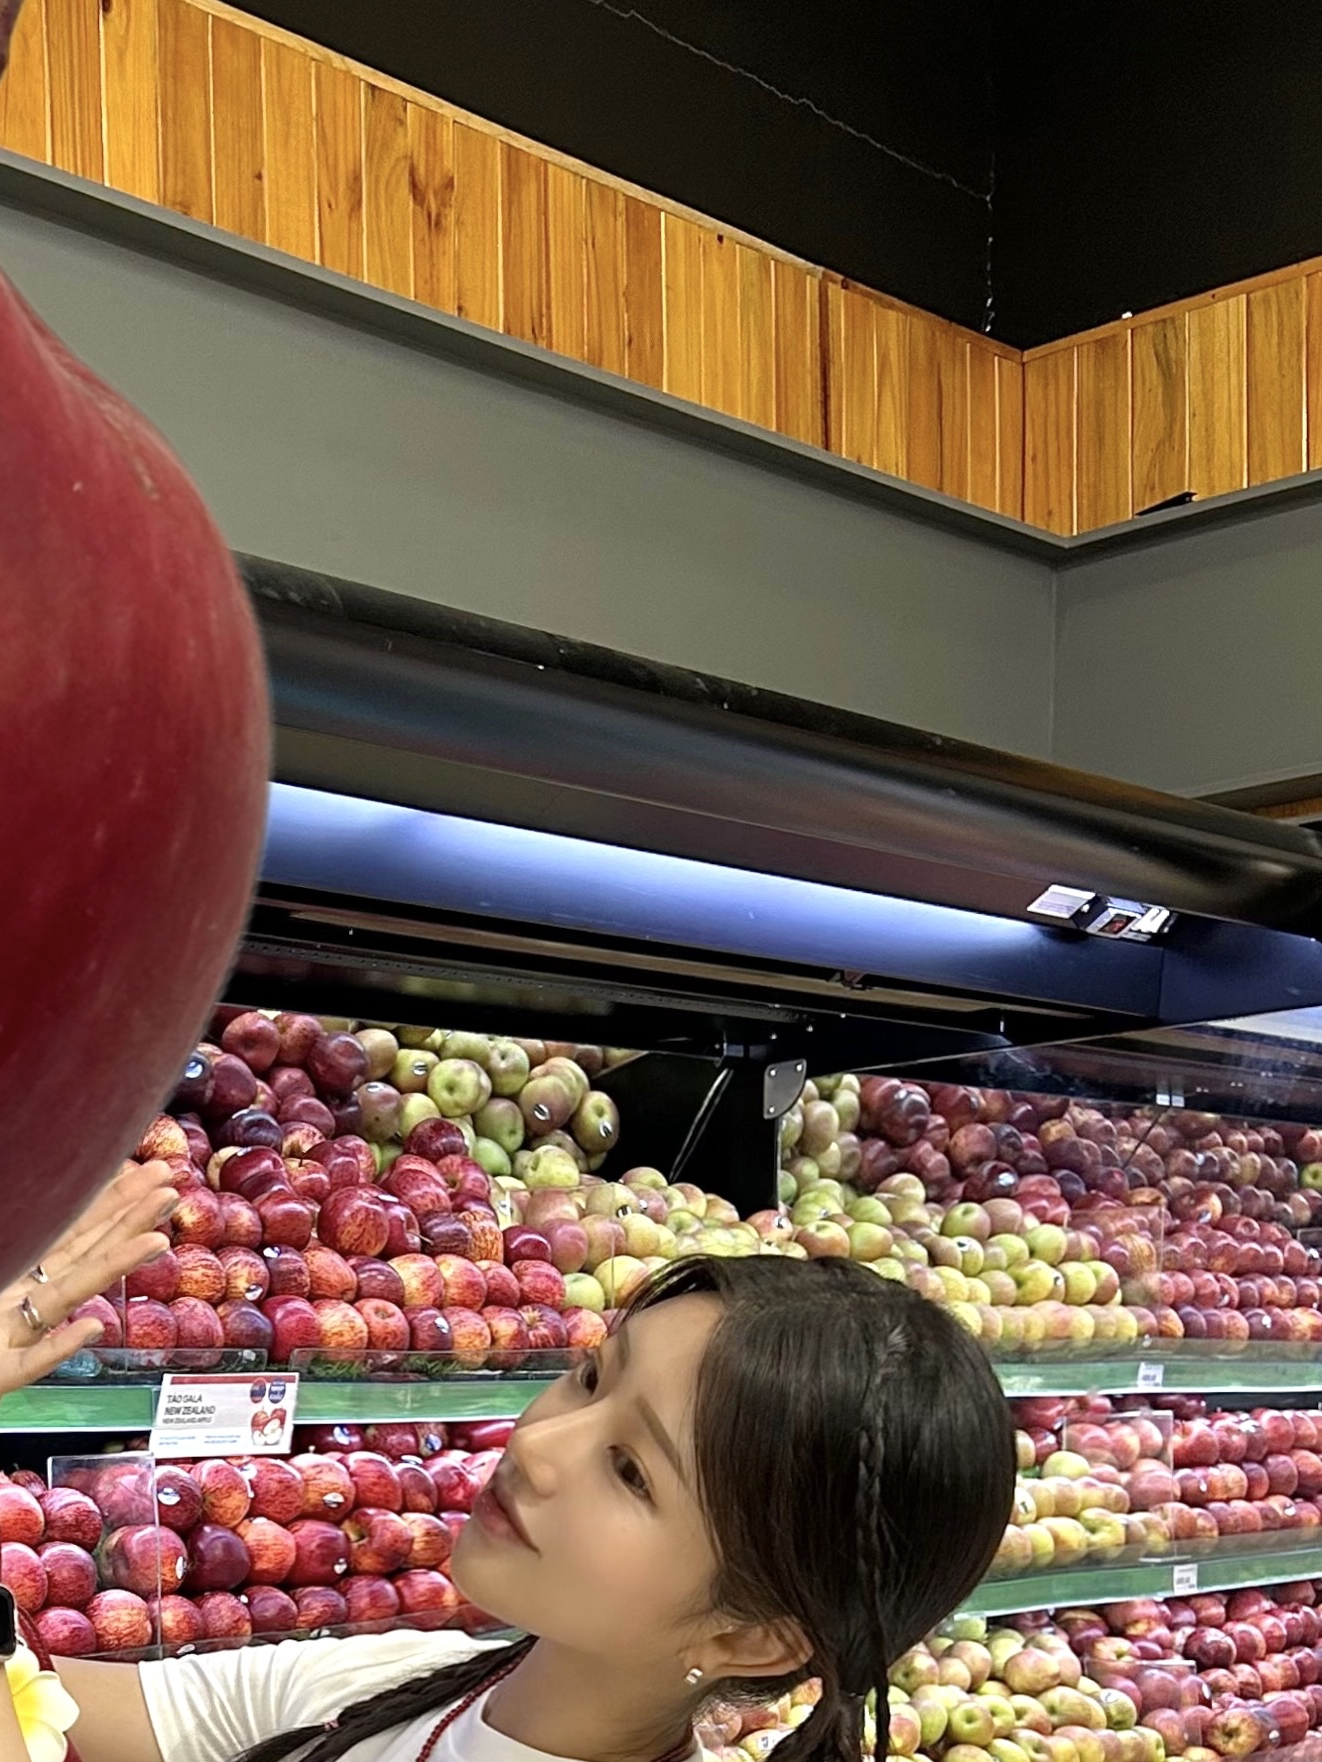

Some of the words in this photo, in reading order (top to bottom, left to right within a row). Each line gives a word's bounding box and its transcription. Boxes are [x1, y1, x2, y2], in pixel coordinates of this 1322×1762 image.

[183, 1394, 202, 1403] GALA
[164, 1406, 181, 1415] NEW
[182, 1405, 216, 1415] ZEALAND
